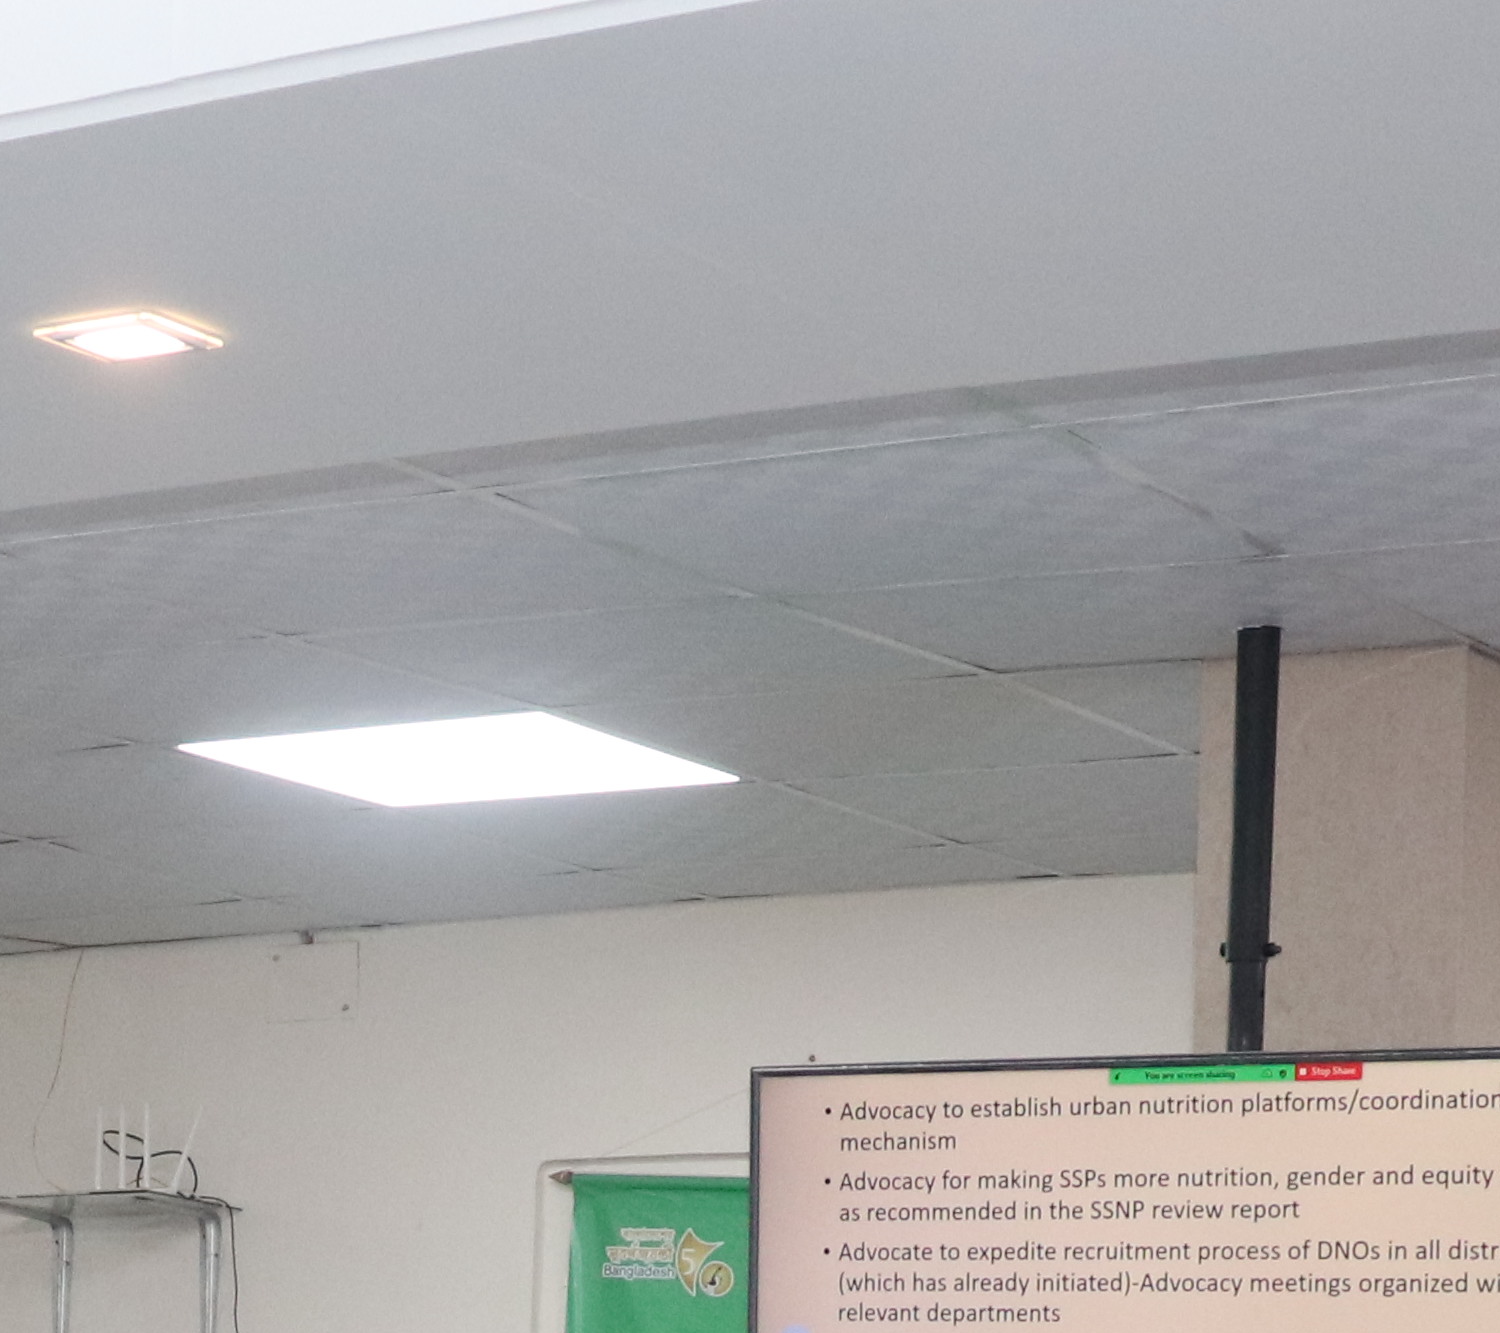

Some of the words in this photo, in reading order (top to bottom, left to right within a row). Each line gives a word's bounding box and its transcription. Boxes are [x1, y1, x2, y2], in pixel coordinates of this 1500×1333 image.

[1311, 1067, 1331, 1079] Stop
[839, 1101, 937, 1123] Advocacy
[942, 1102, 964, 1118] to
[970, 1096, 1062, 1118] establish
[1069, 1096, 1132, 1116] urban
[1138, 1095, 1234, 1114] nutrition
[840, 1131, 957, 1151] mechanism
[839, 1171, 936, 1194] Advocacy
[941, 1170, 972, 1190] for
[977, 1169, 1054, 1193] making
[1059, 1169, 1107, 1188] SSPs
[1113, 1173, 1171, 1187] more
[1177, 1167, 1279, 1190] nutrition,
[1286, 1165, 1366, 1190] gender
[1372, 1164, 1414, 1185] and
[1421, 1165, 1495, 1189] equity
[839, 1208, 861, 1221] as
[867, 1200, 1017, 1221] recommended
[1023, 1201, 1042, 1220] in
[1048, 1200, 1084, 1220] the
[1090, 1200, 1145, 1219] SSNP
[1152, 1200, 1224, 1219] review
[1230, 1201, 1301, 1223] report
[838, 1242, 933, 1261] Advocate
[939, 1244, 961, 1260] to
[966, 1241, 1057, 1265] expedite
[1063, 1241, 1191, 1260] recruitment
[1197, 1246, 1281, 1265] process
[1287, 1239, 1312, 1260] of
[1317, 1241, 1381, 1260] DNOs
[1387, 1241, 1408, 1260] in
[1415, 1239, 1441, 1260] all
[604, 1264, 677, 1280] Bangladesh
[838, 1272, 905, 1295] (which
[912, 1272, 947, 1291] has
[953, 1272, 1030, 1296] already
[1036, 1271, 1244, 1297] initiated)-Advocacy
[1249, 1273, 1352, 1297] meetings
[1358, 1272, 1469, 1297] organized
[838, 1302, 920, 1322] relevant
[926, 1302, 1061, 1326] departments
